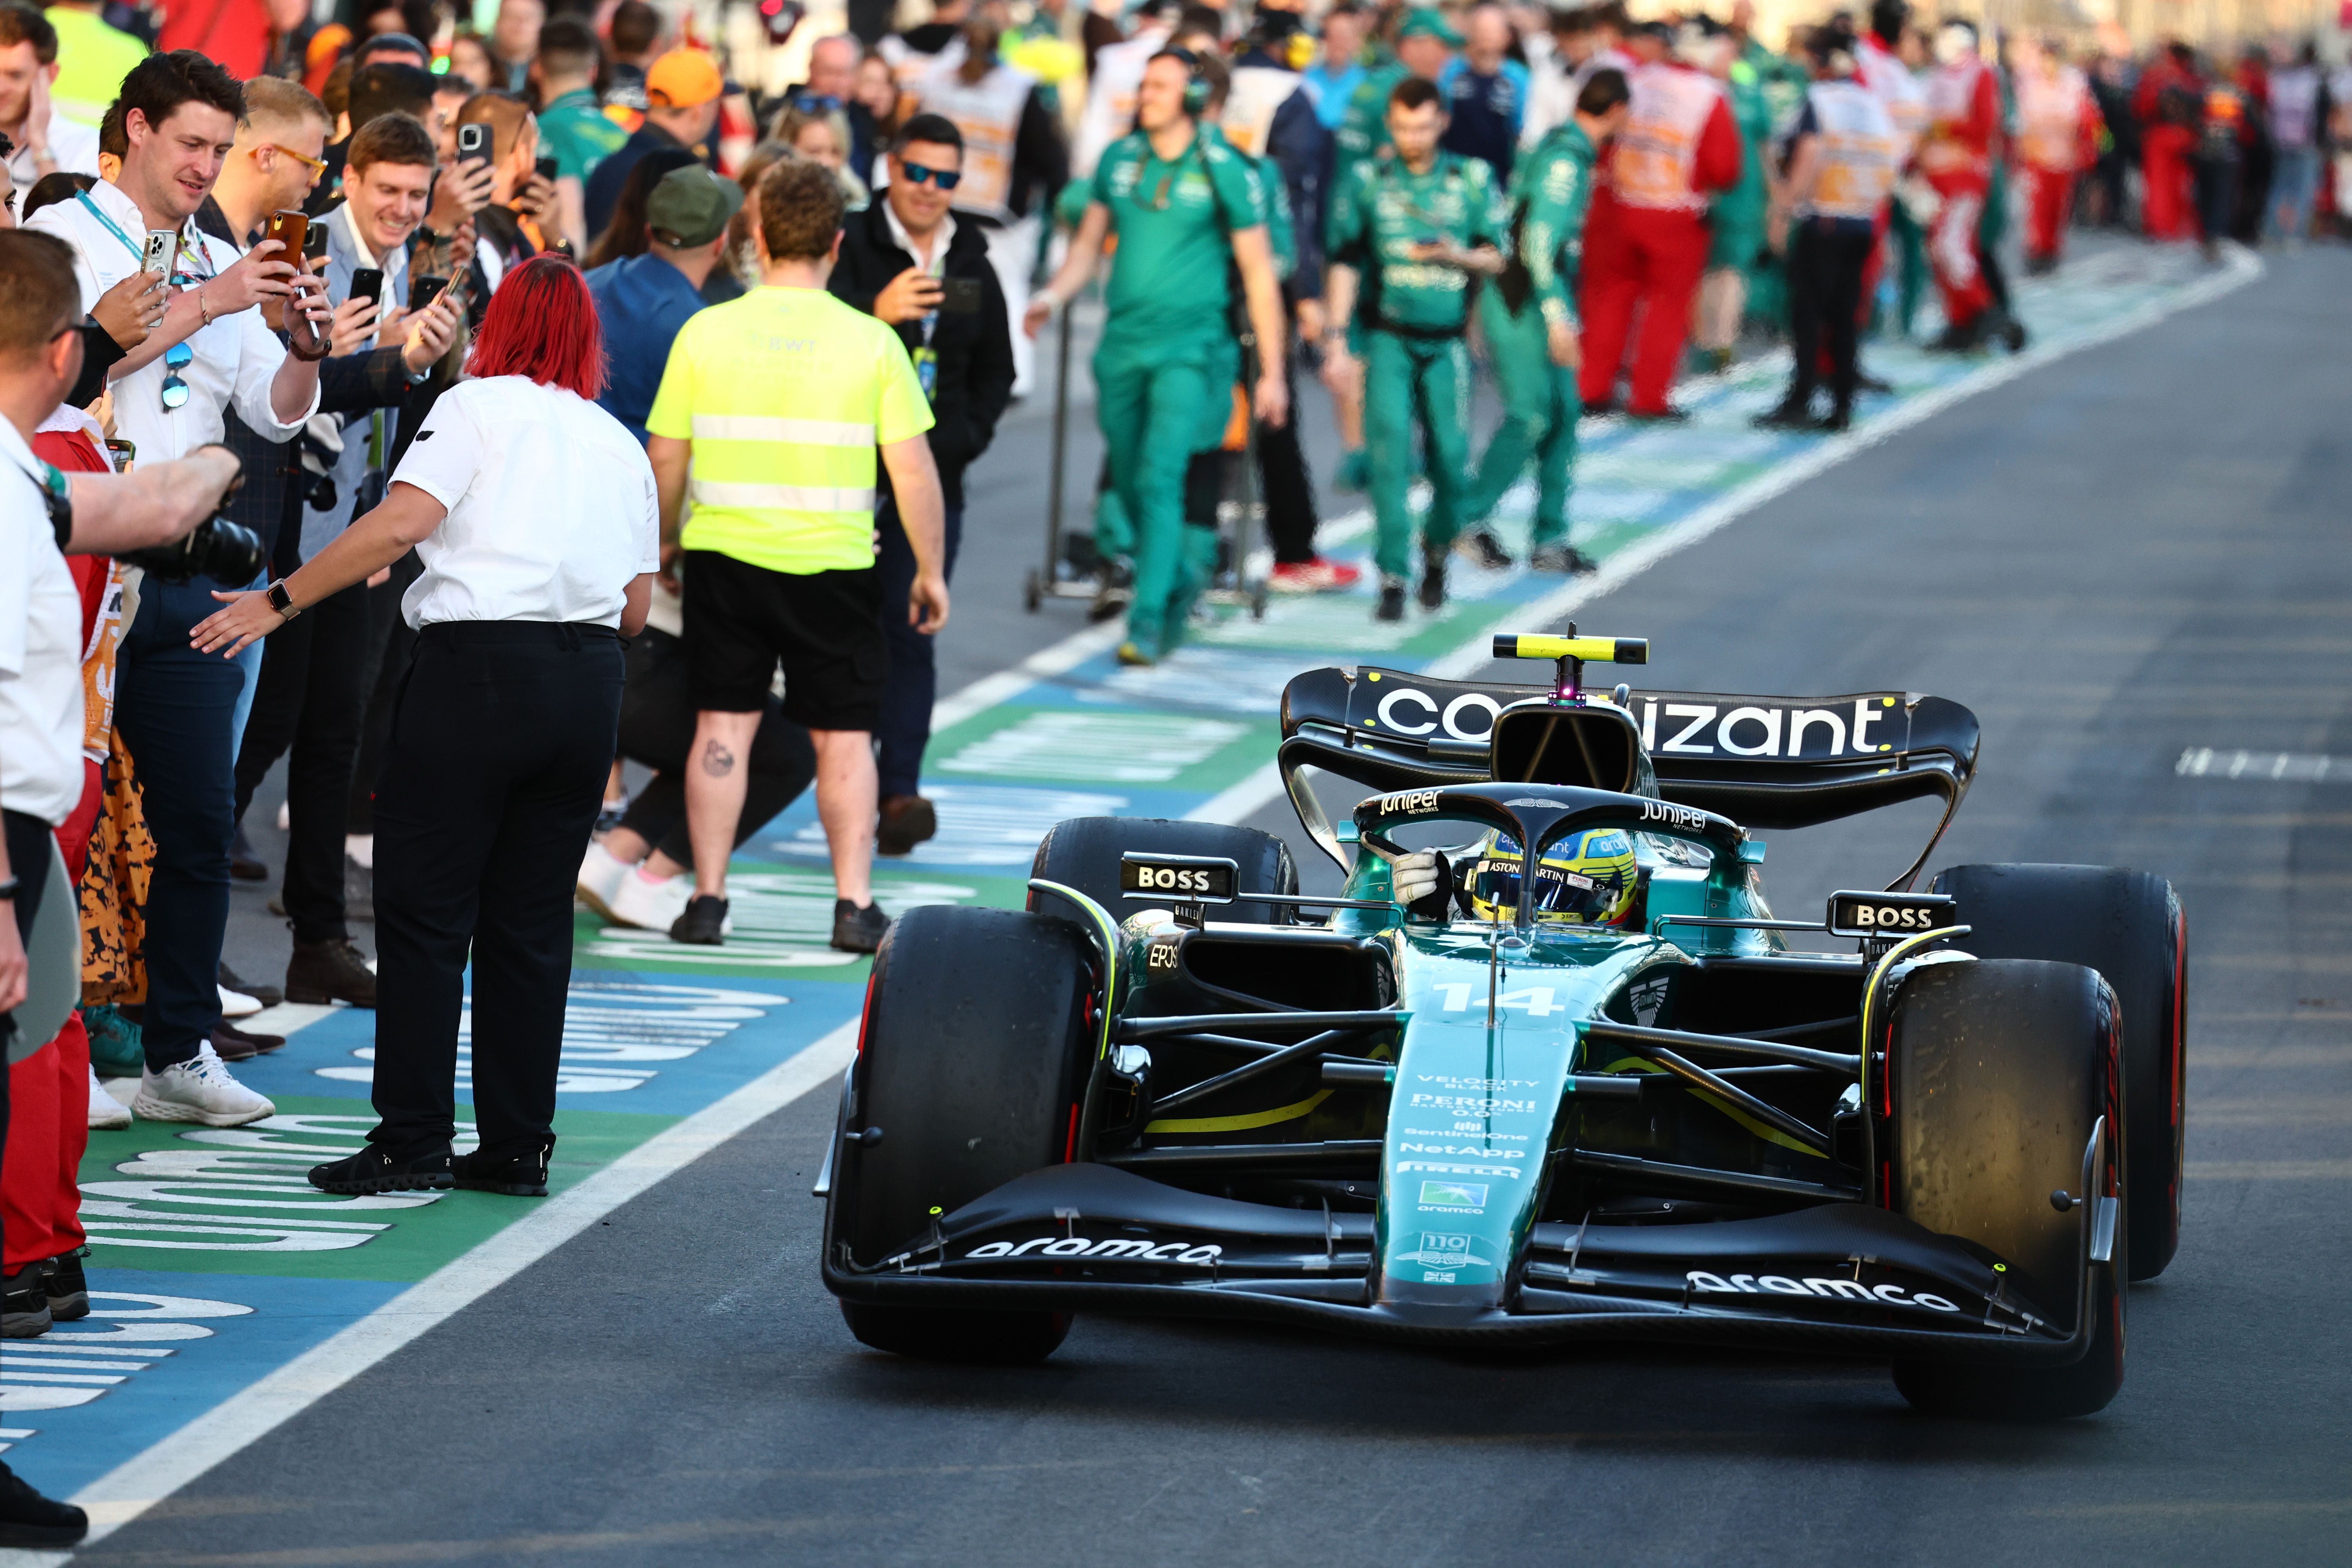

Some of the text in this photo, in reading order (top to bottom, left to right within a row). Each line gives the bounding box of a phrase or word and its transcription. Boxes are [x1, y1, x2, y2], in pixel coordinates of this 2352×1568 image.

[769, 337, 816, 352] BWT
[1378, 689, 1883, 756] coizant
[1407, 805, 1439, 815] NETWORKS
[1672, 823, 1702, 834] NETWORKS
[1139, 867, 1209, 891] BOSS
[1490, 862, 1564, 883] ASTON ARTIN
[1572, 875, 1589, 884] PERONI
[1857, 905, 1932, 928] BOSS
[1150, 944, 1178, 969] EPOS
[1433, 982, 1565, 1016] 14
[1417, 1074, 1540, 1087] VELOCITY
[1445, 1083, 1507, 1091] BLACK
[1412, 1093, 1536, 1109] PERONI
[1404, 1128, 1528, 1141] SentinelOne
[1399, 1143, 1525, 1159] NetApp
[1396, 1161, 1522, 1179] PIRELLI
[1417, 1206, 1484, 1214] aramco
[1426, 1235, 1466, 1248] 110
[965, 1237, 1222, 1264] aramco
[1686, 1270, 1961, 1312] aramco
